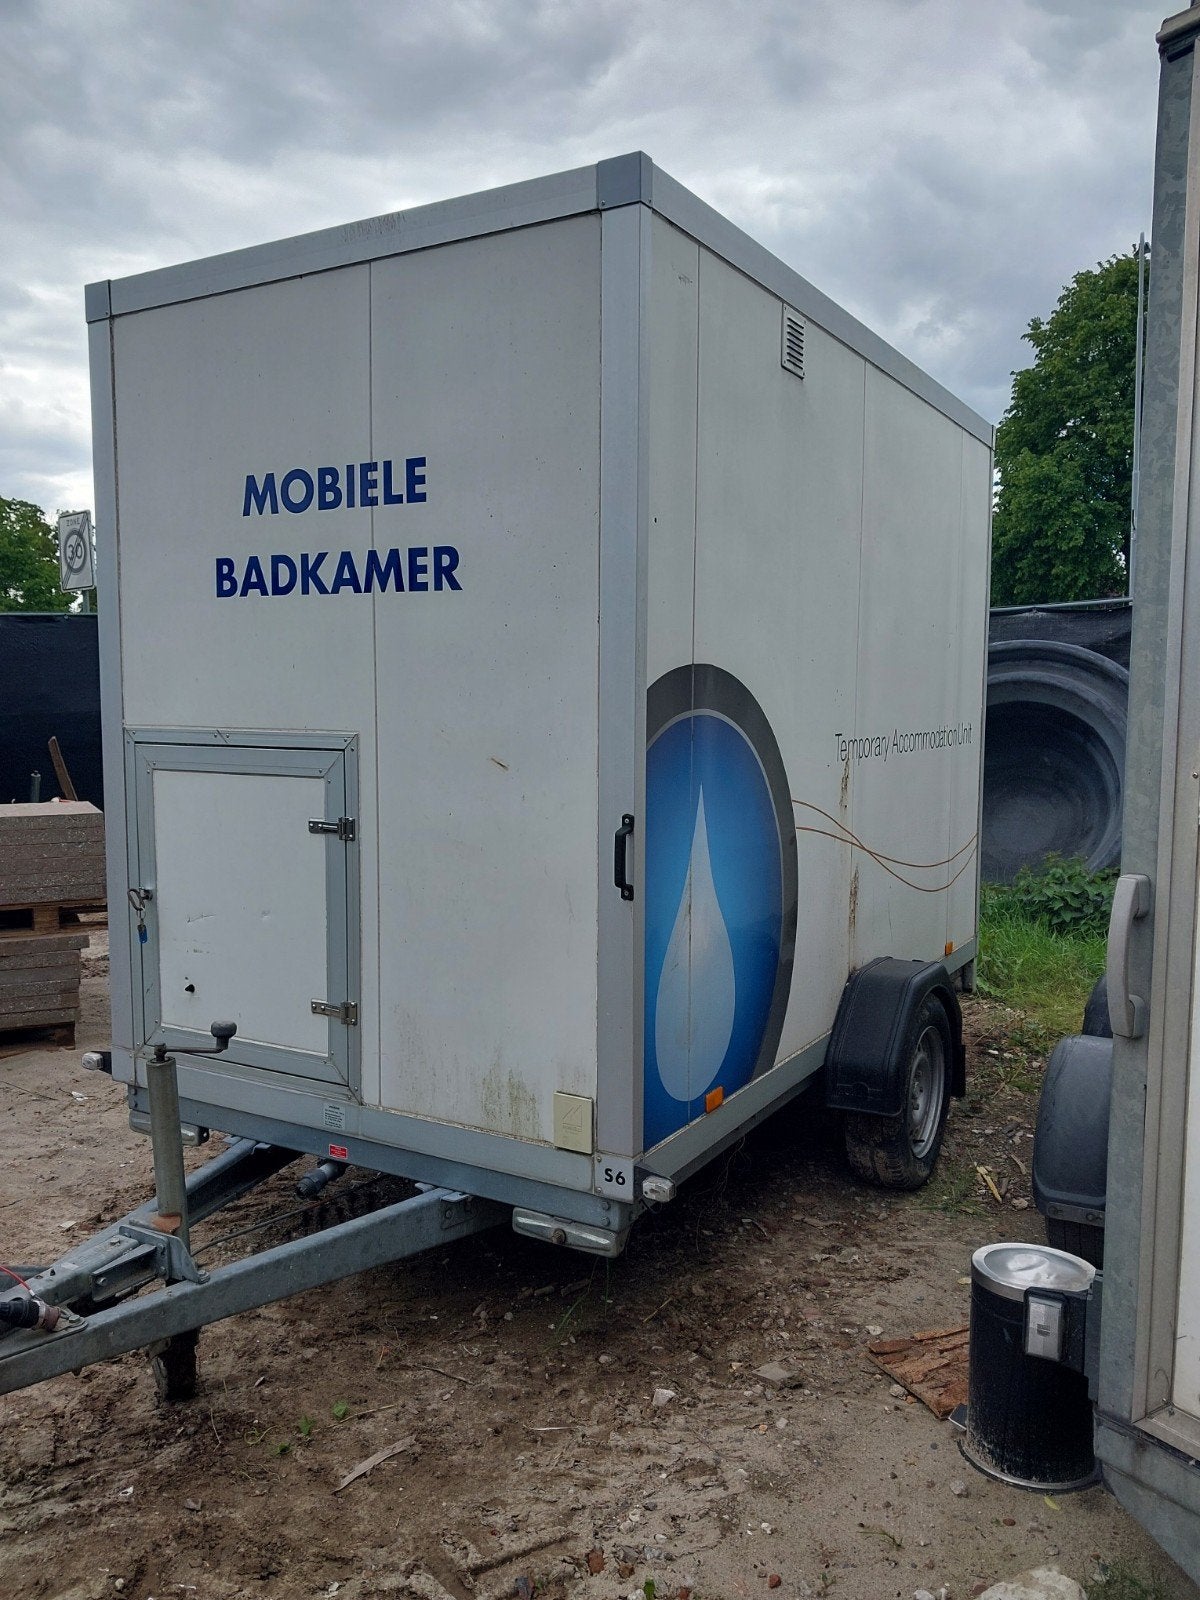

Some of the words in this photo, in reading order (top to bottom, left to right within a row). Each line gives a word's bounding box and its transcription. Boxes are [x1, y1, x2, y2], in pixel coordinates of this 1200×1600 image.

[242, 456, 427, 517] MOBIELE
[66, 517, 81, 527] ZONE
[67, 542, 82, 560] 30
[216, 546, 463, 598] BADKAMER
[835, 732, 889, 766] Temporary
[891, 724, 957, 754] Accommodation
[958, 722, 972, 744] Unit
[604, 1167, 626, 1186] S6
